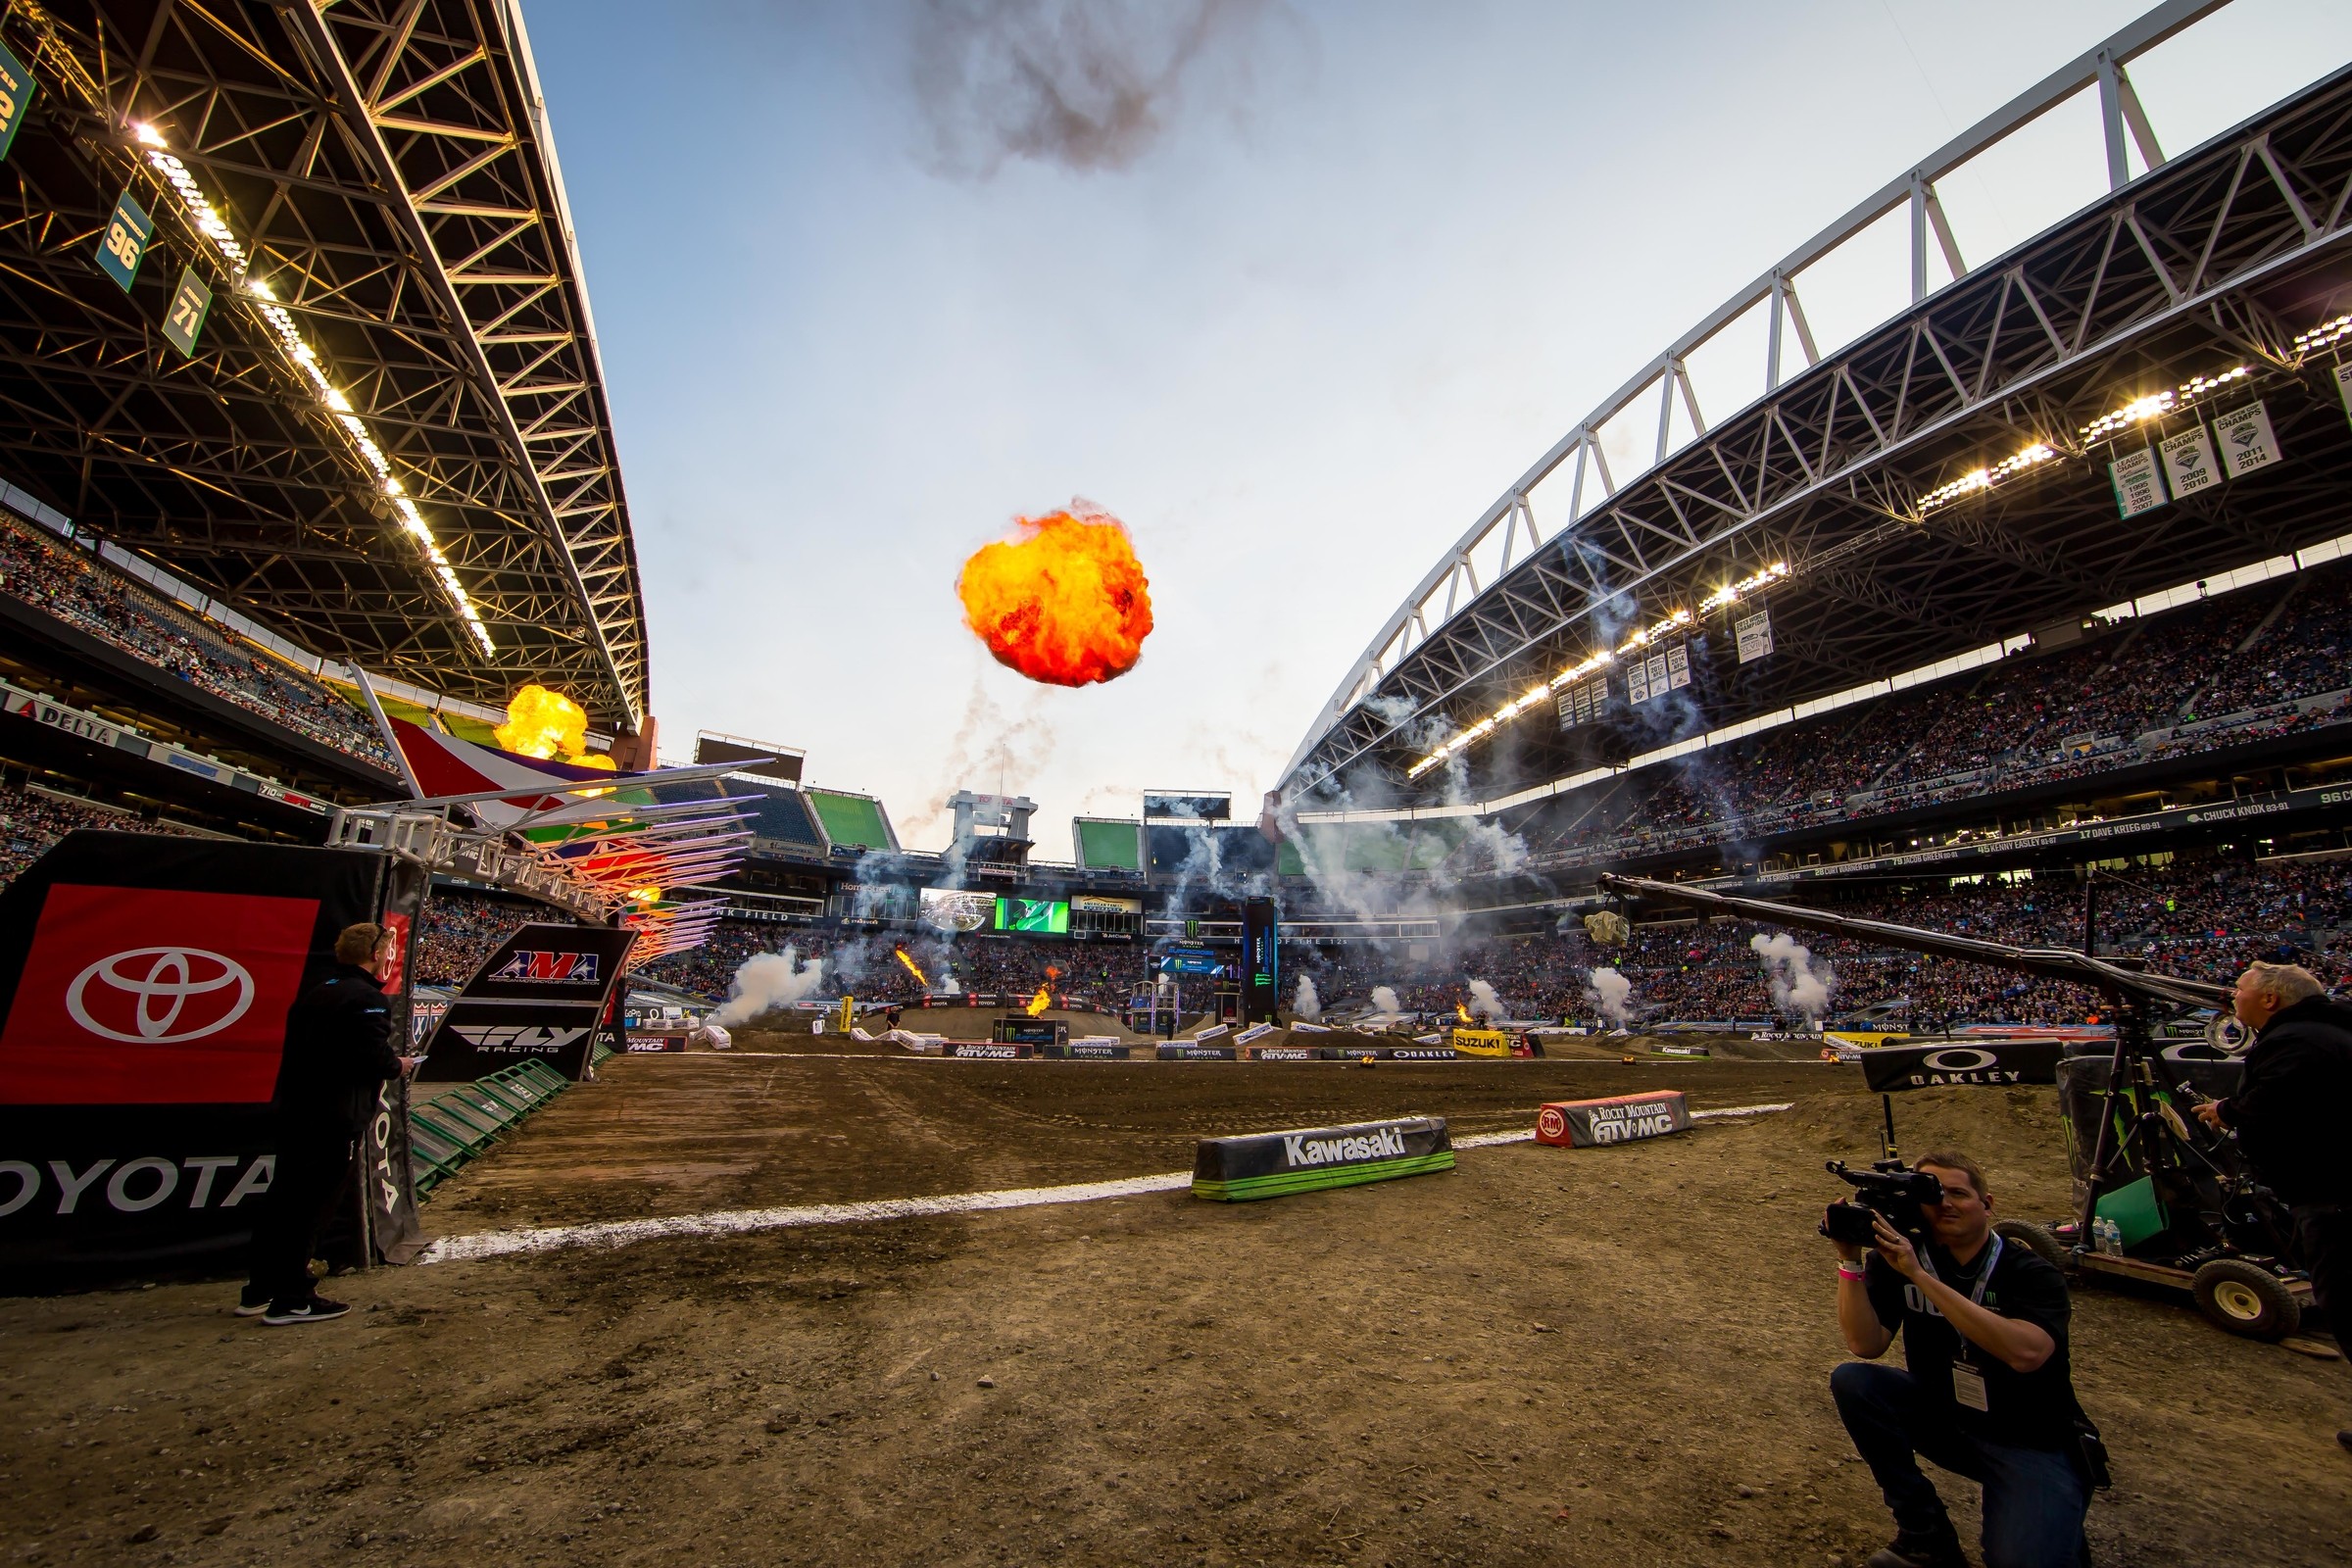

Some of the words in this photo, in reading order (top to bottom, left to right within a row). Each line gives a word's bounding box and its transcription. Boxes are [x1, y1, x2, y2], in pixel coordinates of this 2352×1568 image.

[106, 222, 140, 270] 96
[172, 296, 200, 338] 71
[2218, 408, 2262, 431] CHAMPS
[2164, 431, 2204, 453] CHAMPS
[2117, 452, 2144, 467] LEAGUE
[2236, 445, 2263, 462] 2011
[2117, 456, 2149, 473] CHAMPS
[2238, 454, 2267, 470] 2014
[2180, 467, 2207, 483] 2009
[2182, 475, 2209, 491] 2010
[2129, 480, 2148, 493] 1995
[2132, 493, 2152, 506] 2005
[2132, 501, 2153, 513] 2007
[1736, 618, 1749, 629] 2013
[1749, 612, 1767, 623] WORLD
[1737, 617, 1768, 634] CHAMPIONS
[1671, 655, 1685, 665] 2014
[42, 706, 111, 744] DELTA
[261, 785, 277, 797] 710
[2203, 808, 2237, 822] CHUCK
[2237, 804, 2266, 817] KNOX
[2266, 802, 2290, 812] 83-91
[2080, 829, 2091, 840] 17
[2091, 827, 2113, 838] DAVE
[2114, 822, 2140, 834] KRIEG
[2140, 821, 2162, 831] 80-91
[1978, 845, 1990, 854] 45
[1990, 841, 2014, 853] KENNY
[2014, 837, 2040, 850] EASLEY
[1892, 858, 1903, 866] 79
[1903, 855, 1922, 865] JACOB
[1923, 852, 1943, 862] GREEN
[1838, 864, 1863, 874] WARNER
[841, 882, 892, 893] HomeStreet
[745, 910, 788, 921] FIELD
[488, 950, 601, 982] AMA
[450, 1025, 593, 1047] FLY
[1873, 1023, 1926, 1033] MONSTR
[1455, 1036, 1500, 1050] SUZUKI
[1661, 1046, 1691, 1054] Kawasaki
[1909, 1070, 2021, 1086] OAKLEY
[1597, 1106, 1625, 1120] ROCKY
[1624, 1102, 1668, 1118] MOUNTAIN
[1543, 1116, 1559, 1128] RM
[1283, 1127, 1406, 1166] Kawasaki
[0, 1154, 277, 1218] OYOTA
